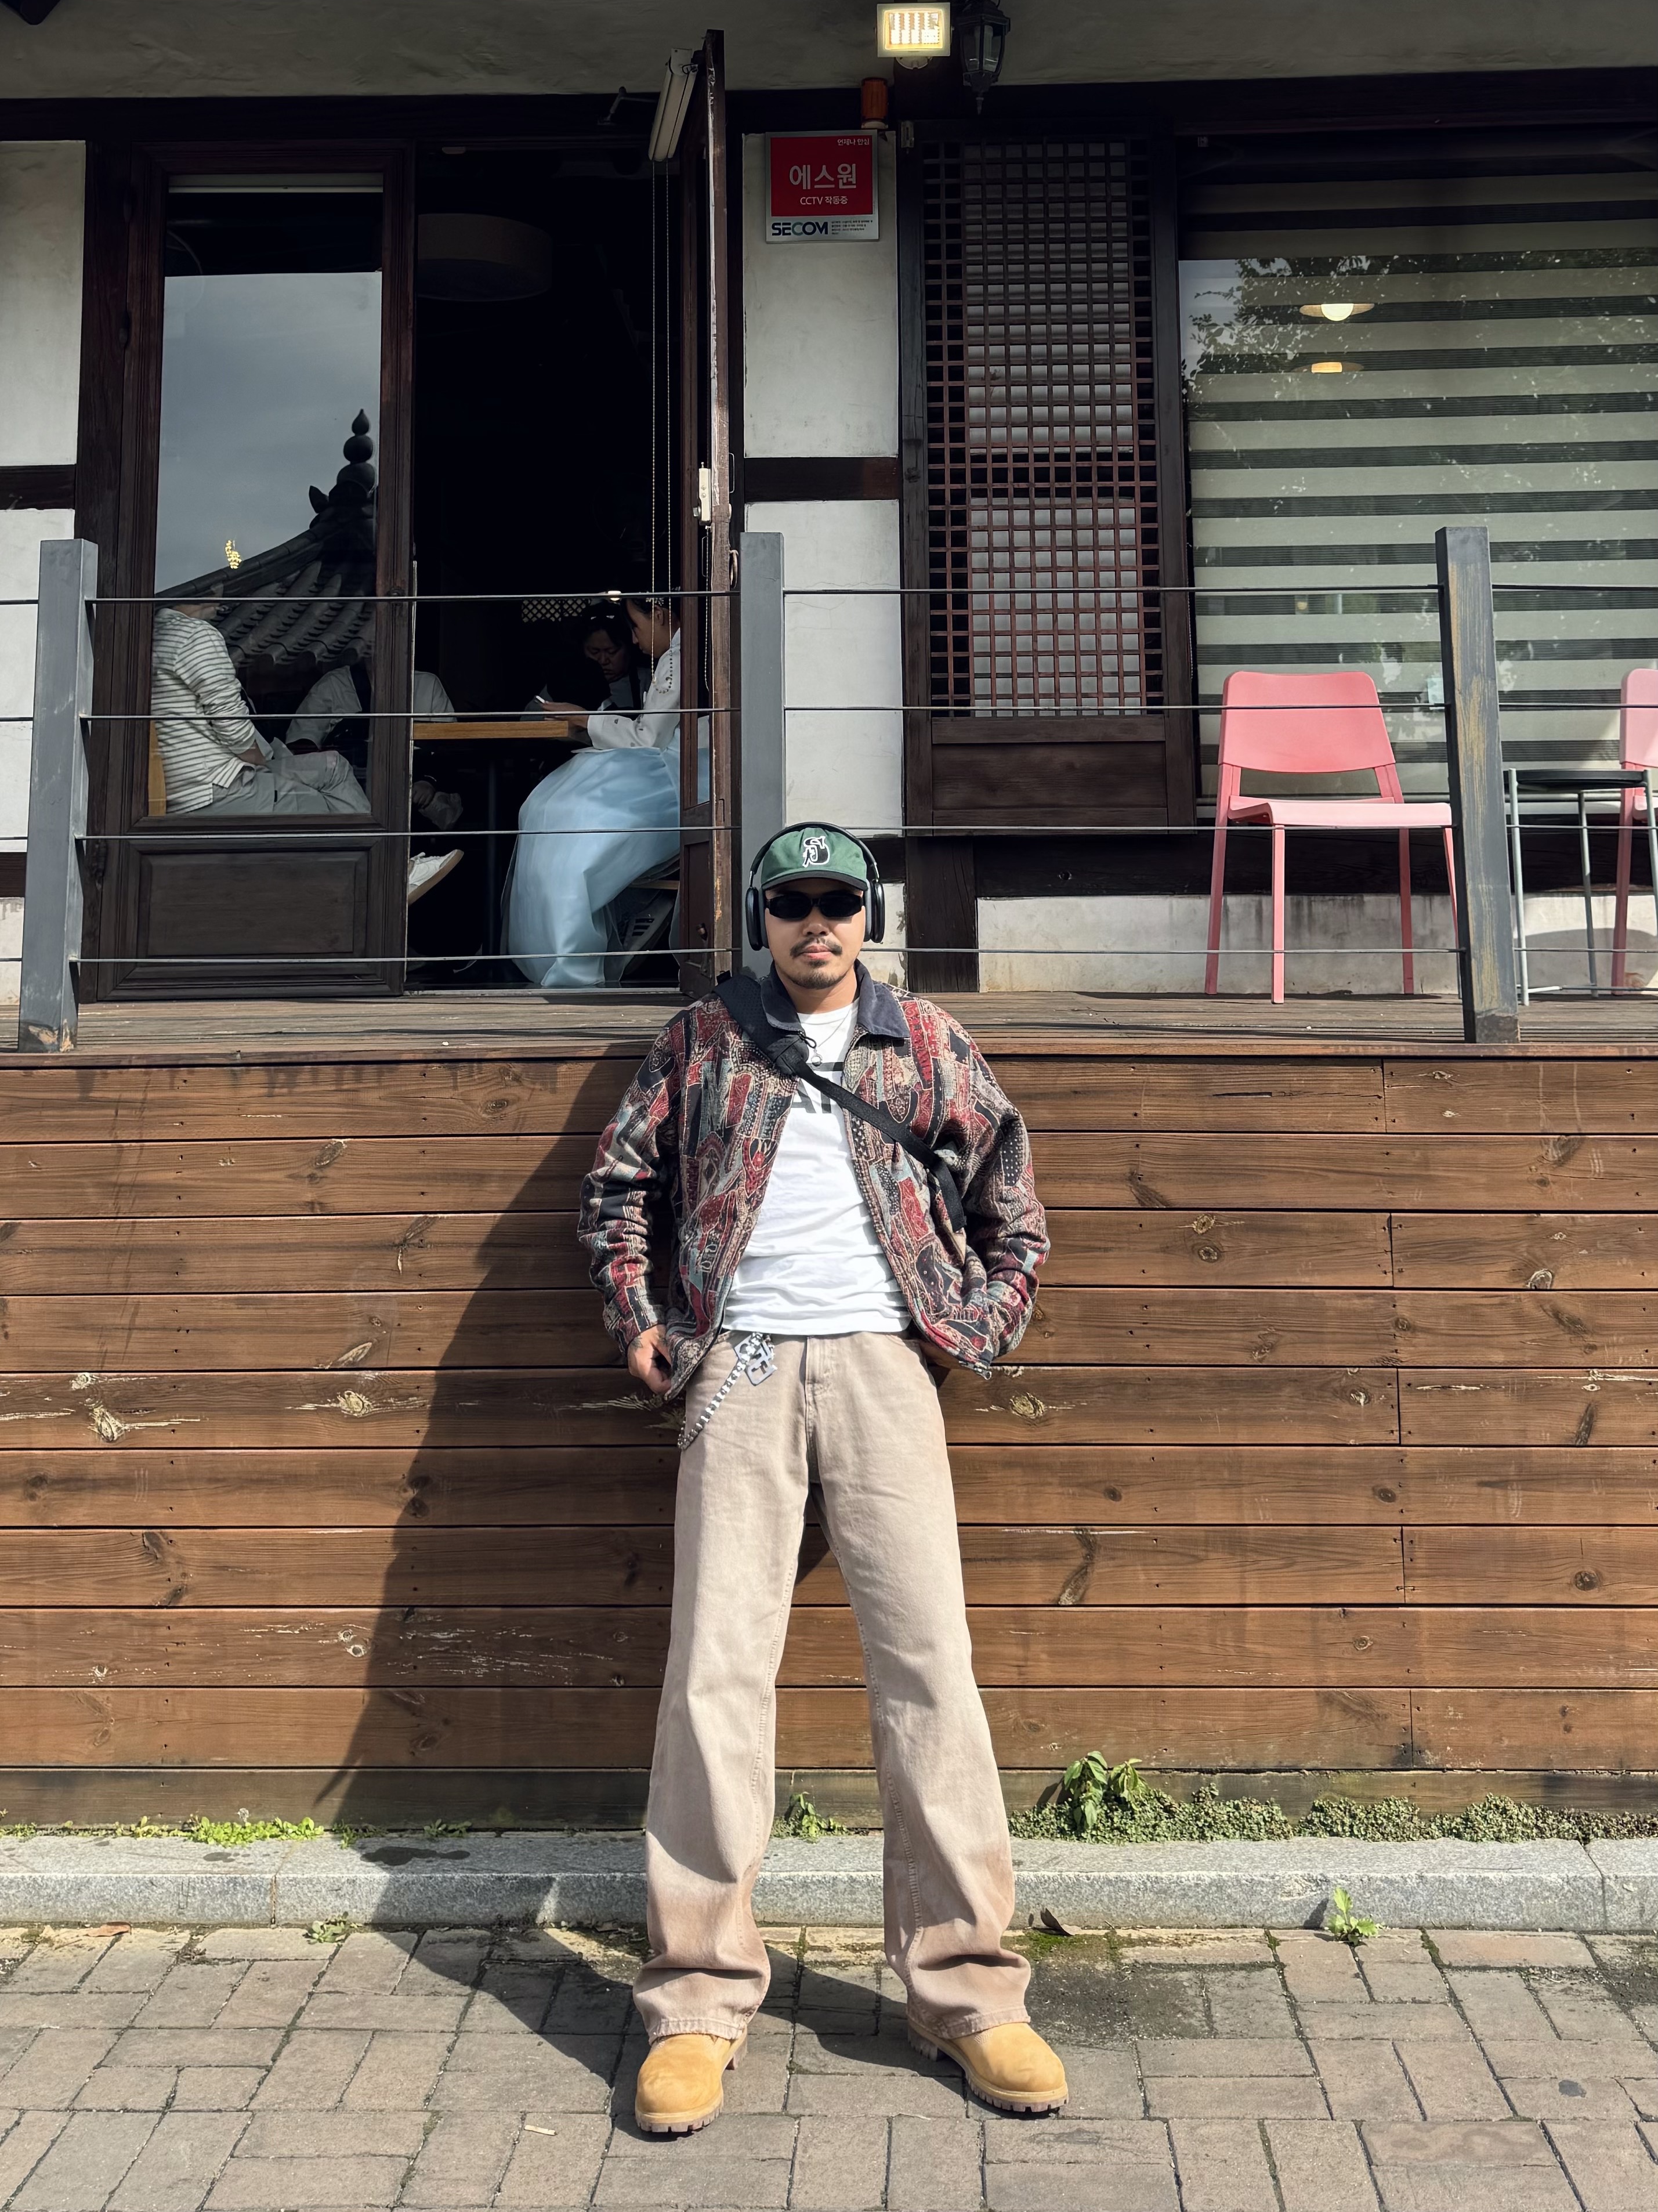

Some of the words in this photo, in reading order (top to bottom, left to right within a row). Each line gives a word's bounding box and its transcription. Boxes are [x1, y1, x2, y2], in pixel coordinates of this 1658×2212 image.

[789, 163, 856, 190] 에스원
[800, 197, 823, 205] CCTV
[825, 196, 848, 205] 작동중
[772, 222, 828, 236] SECOM
